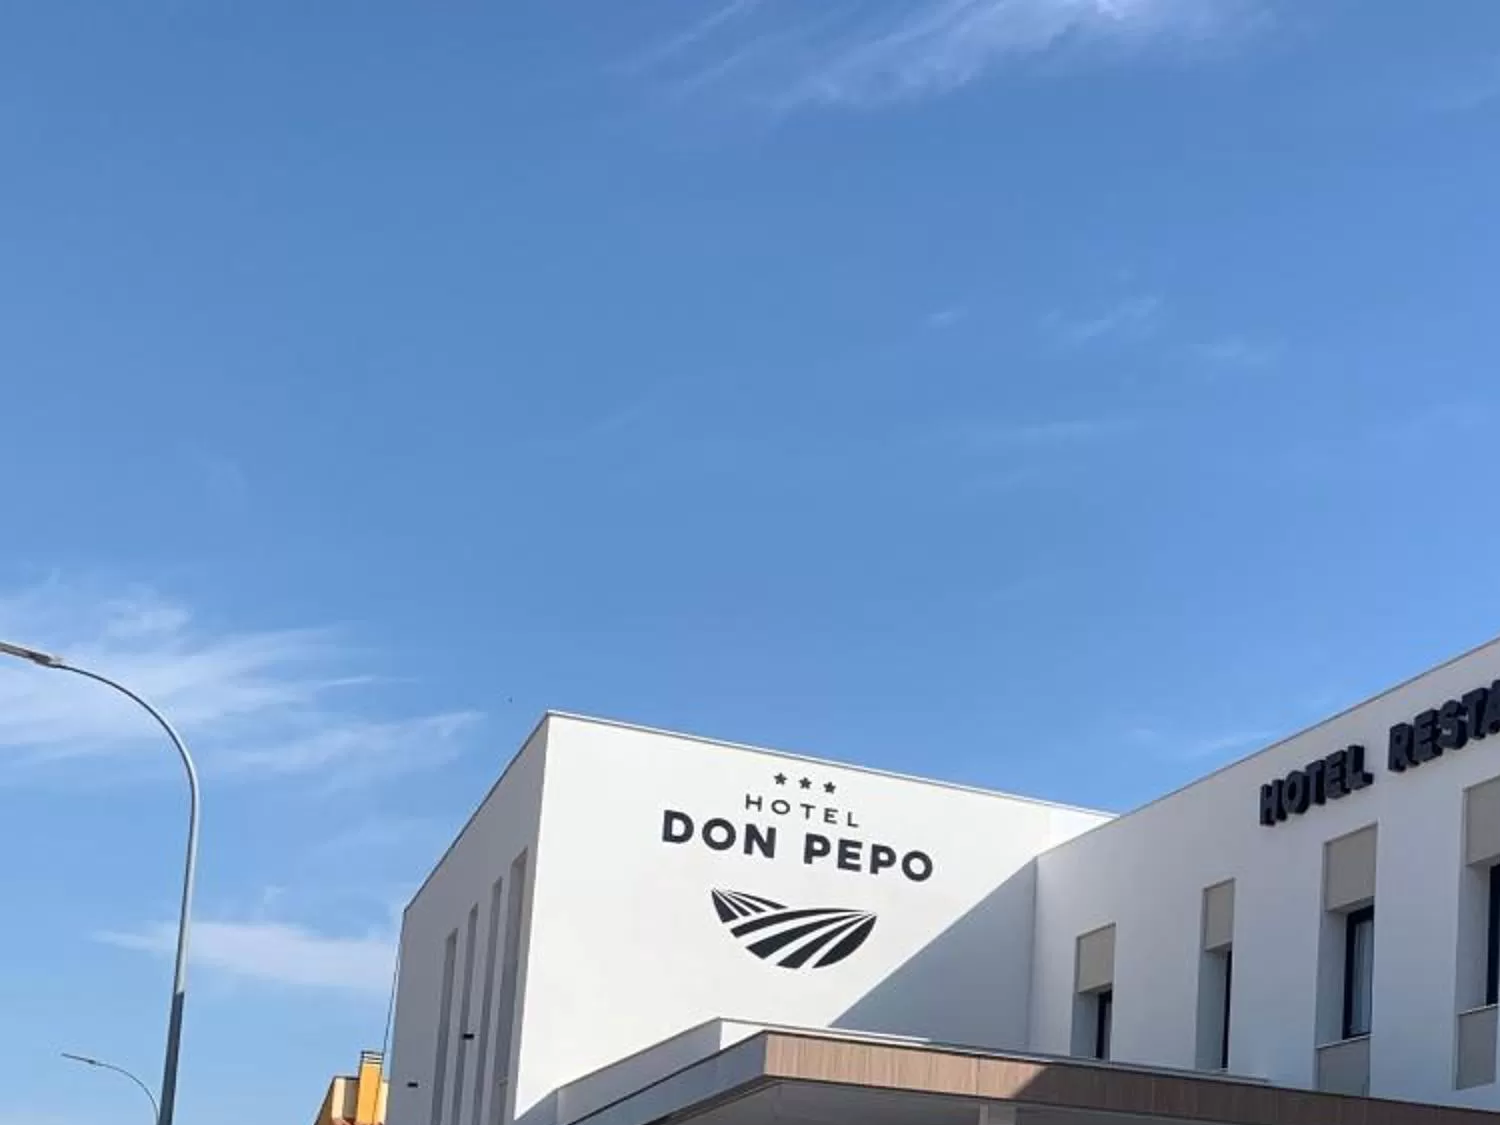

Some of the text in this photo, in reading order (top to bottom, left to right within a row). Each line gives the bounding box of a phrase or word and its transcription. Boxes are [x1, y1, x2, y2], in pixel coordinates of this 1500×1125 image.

[745, 793, 859, 827] HOTEL
[1260, 745, 1374, 826] HOTEL
[662, 809, 933, 882] DON PEPO
